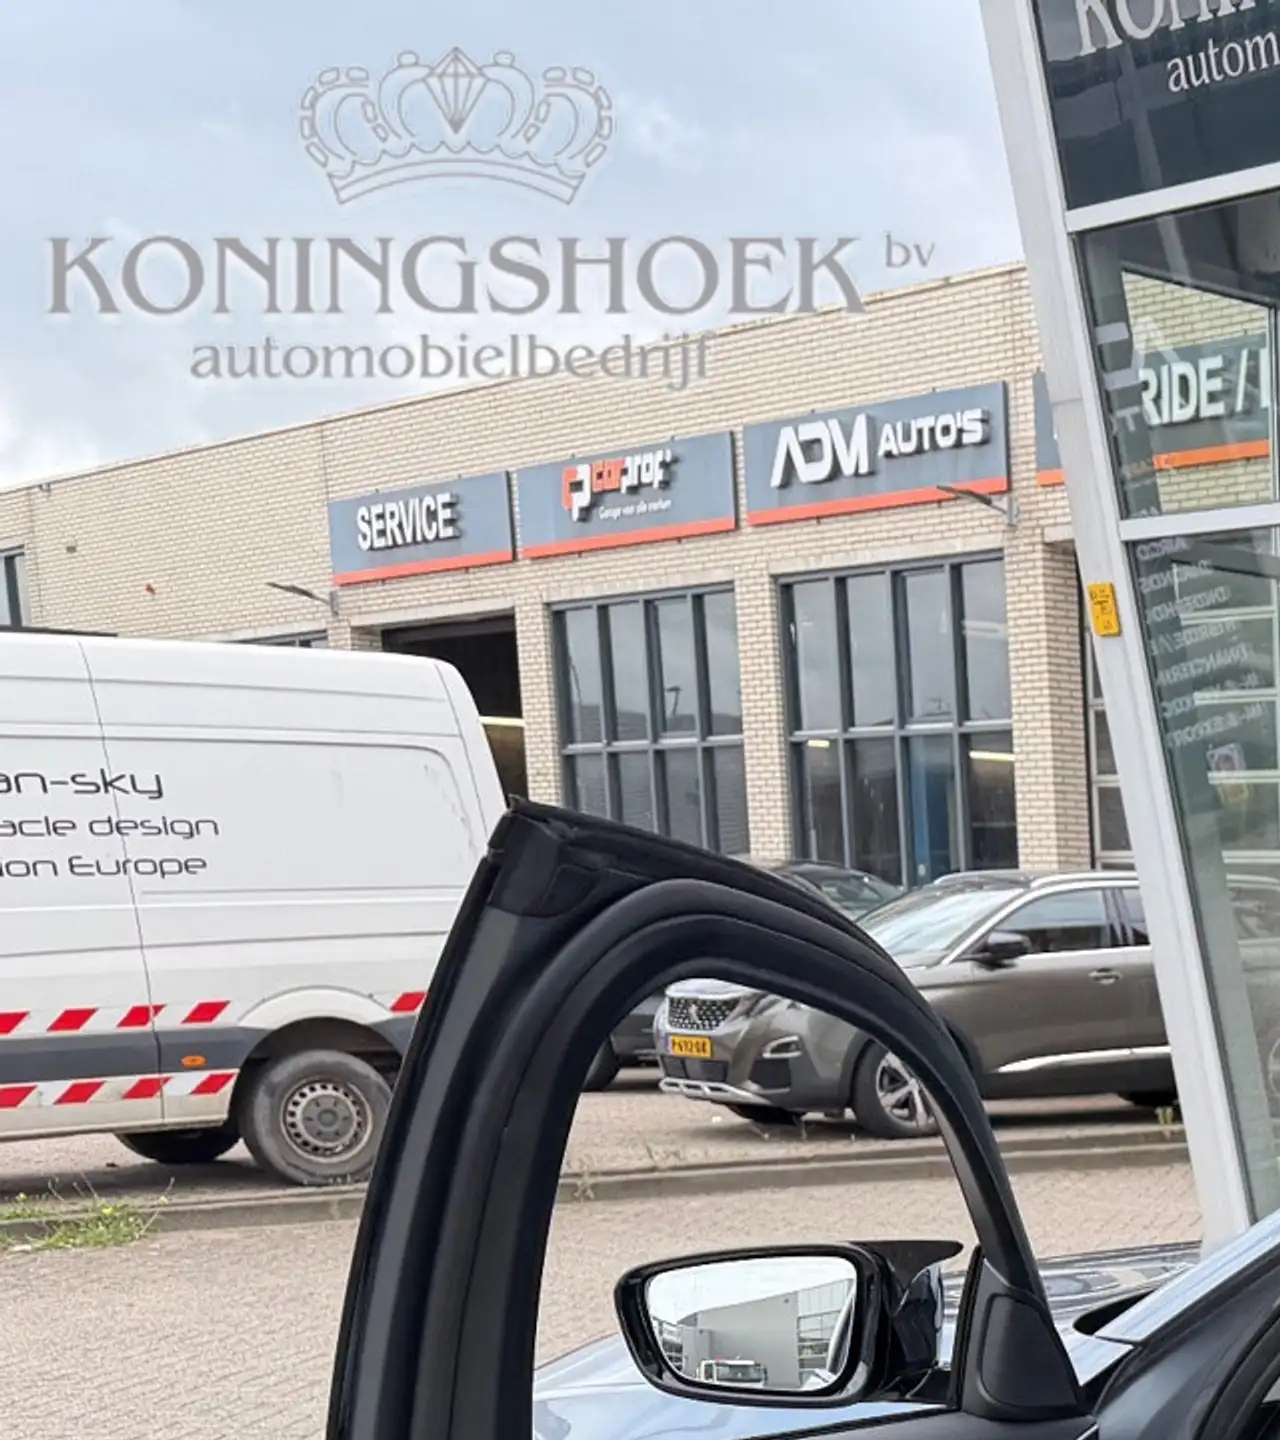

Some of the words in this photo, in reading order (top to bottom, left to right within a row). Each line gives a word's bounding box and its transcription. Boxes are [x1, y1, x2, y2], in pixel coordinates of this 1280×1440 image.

[770, 413, 873, 488] ADM
[877, 408, 990, 458] AUTO'S
[357, 492, 456, 551] SERVICE
[88, 815, 219, 839] design
[68, 856, 207, 879] Europe
